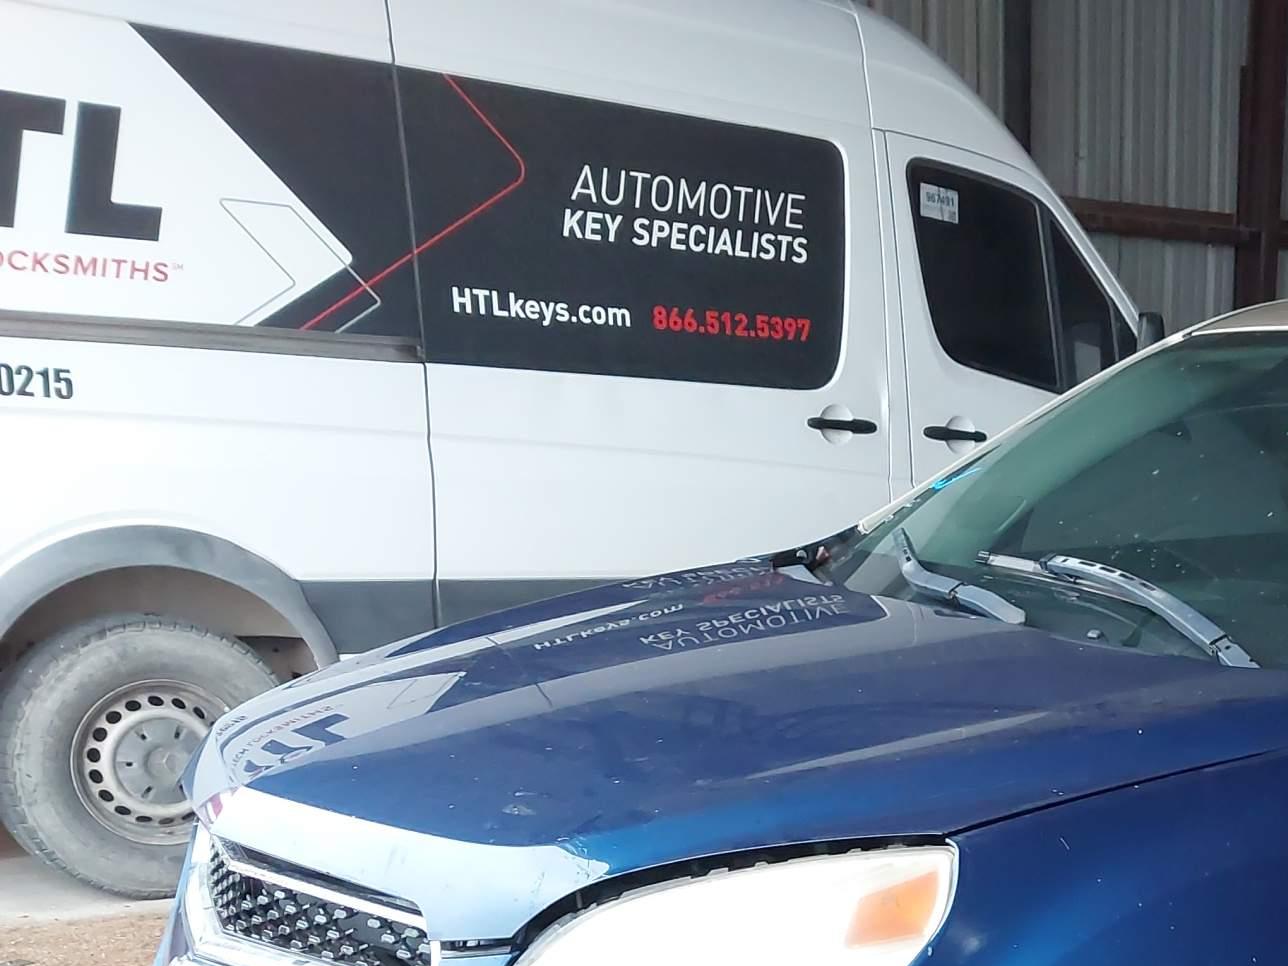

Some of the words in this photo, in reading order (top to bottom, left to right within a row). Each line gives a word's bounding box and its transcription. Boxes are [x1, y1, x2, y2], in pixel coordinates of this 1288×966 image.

[570, 164, 806, 230] AUTOMOTIVE
[562, 208, 624, 243] KEY
[631, 217, 809, 264] SPECIALISTS
[0, 249, 170, 283] CKSMITHS
[451, 286, 632, 328] HTLkeys.com
[652, 305, 811, 342] 866.512.5397
